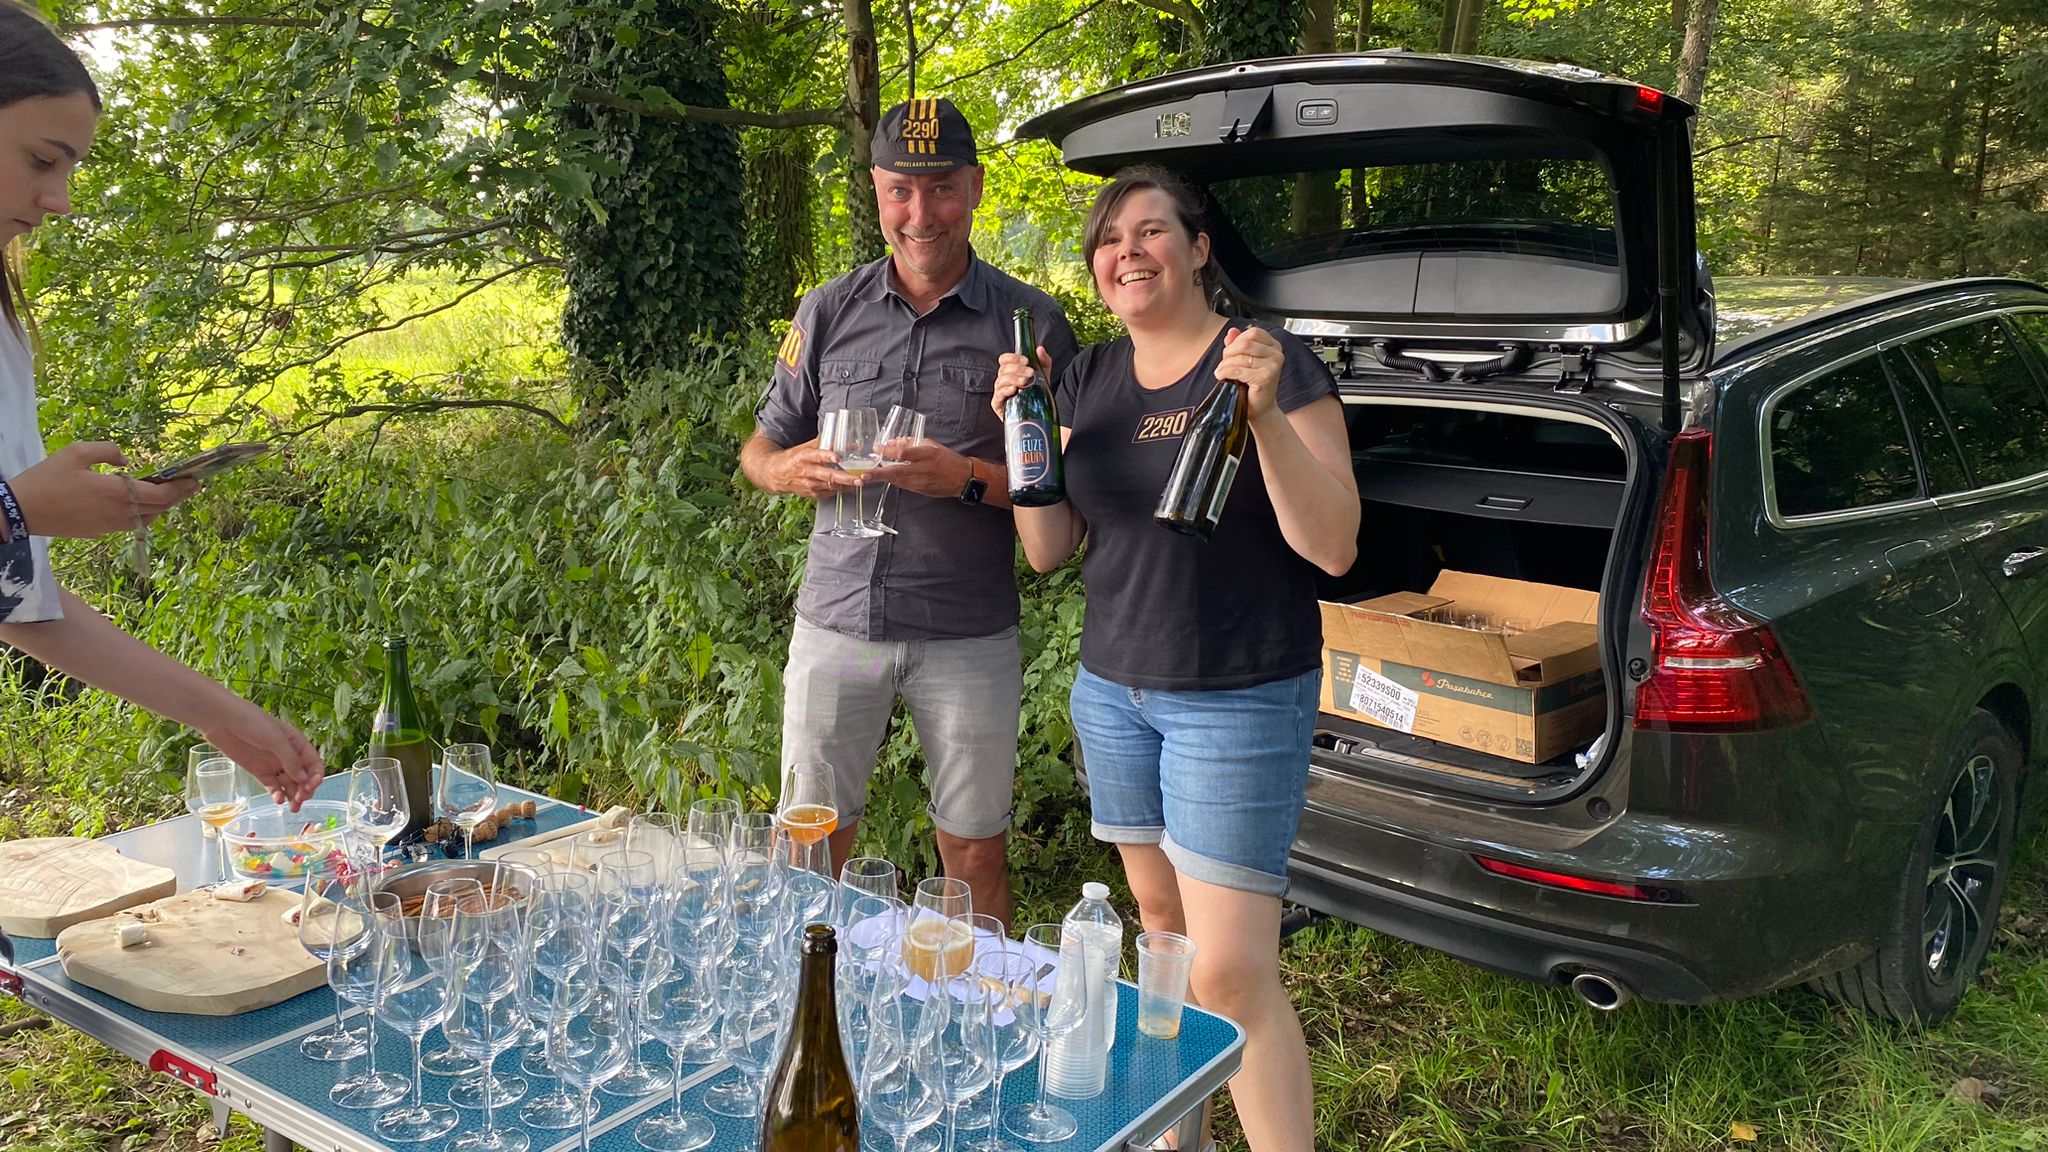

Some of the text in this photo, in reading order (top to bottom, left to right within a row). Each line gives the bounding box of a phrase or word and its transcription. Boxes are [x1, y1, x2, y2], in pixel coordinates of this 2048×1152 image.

[902, 118, 940, 139] 2290
[1138, 411, 1188, 440] 2290
[1361, 673, 1401, 701] 52339S00
[1359, 694, 1404, 723] 8071540514
